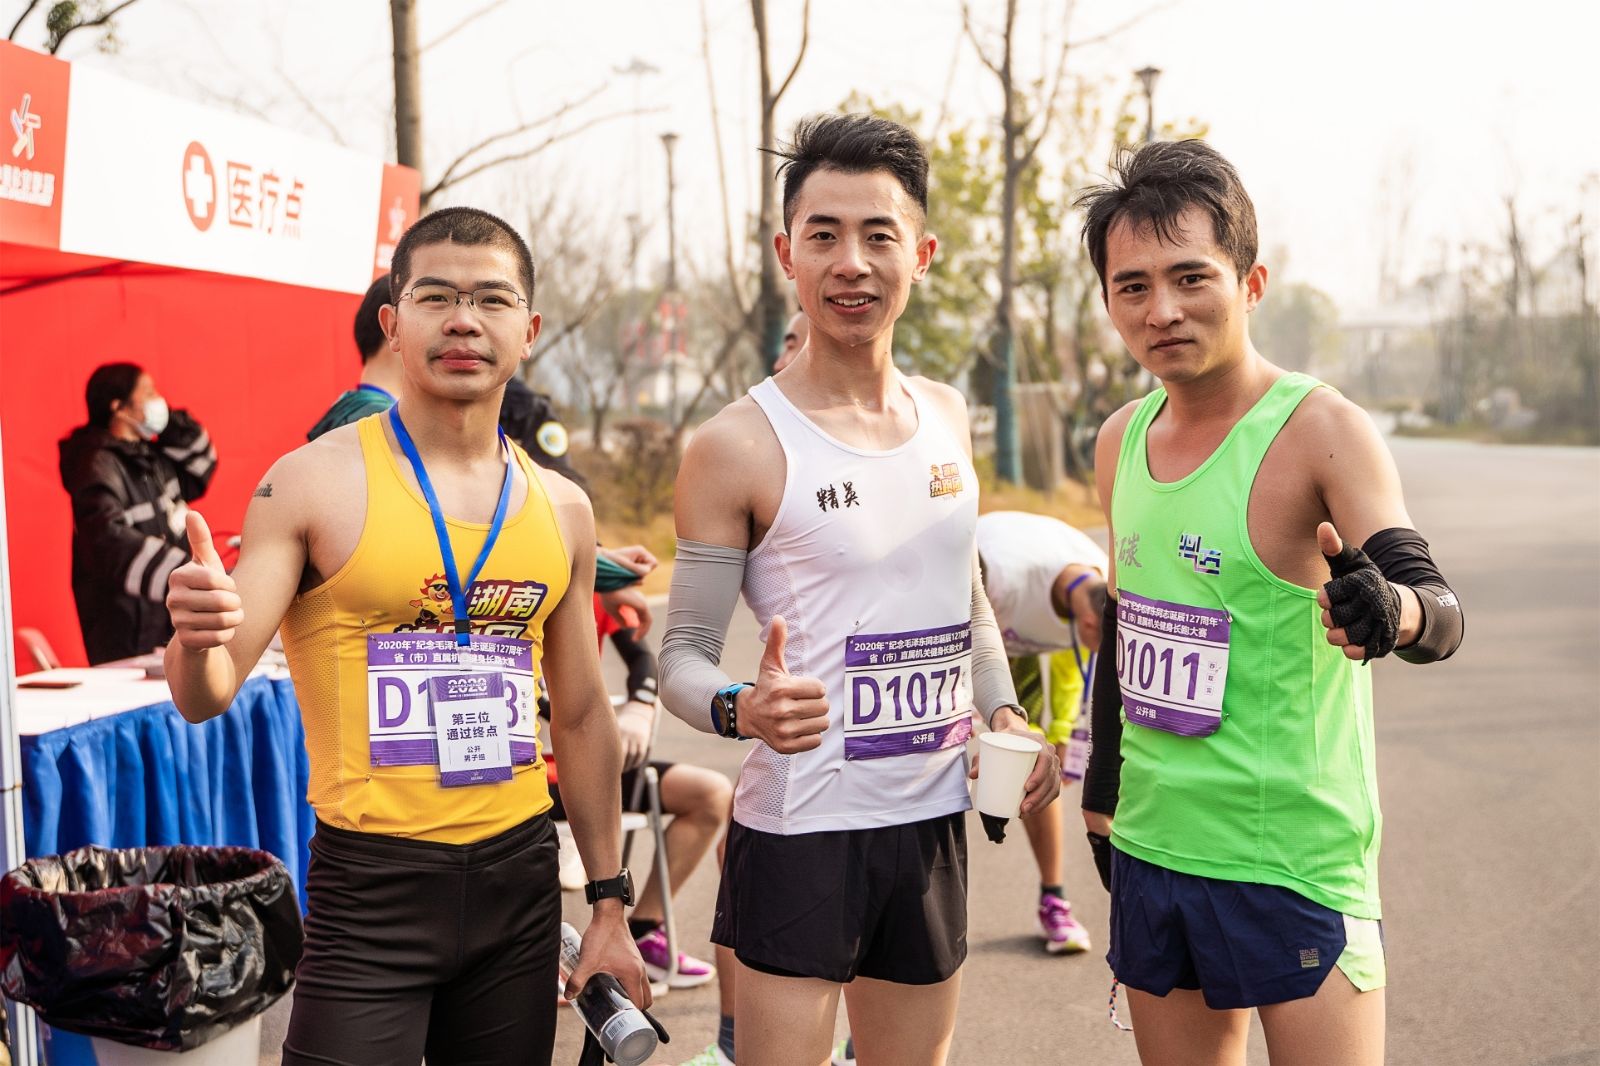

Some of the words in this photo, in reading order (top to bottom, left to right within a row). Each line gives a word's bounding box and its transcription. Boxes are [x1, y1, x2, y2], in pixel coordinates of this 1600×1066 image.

[226, 160, 304, 236] 医疗点
[816, 481, 860, 512] 精英
[469, 585, 543, 617] 湖南
[1117, 630, 1200, 701] D1011
[852, 666, 961, 725] D1077
[452, 711, 491, 726] 第三位
[1136, 705, 1157, 719] 公开组
[447, 725, 498, 741] 通过终点
[912, 732, 935, 745] 公开组
[467, 745, 481, 753] 公开
[464, 753, 486, 762] 男子组
